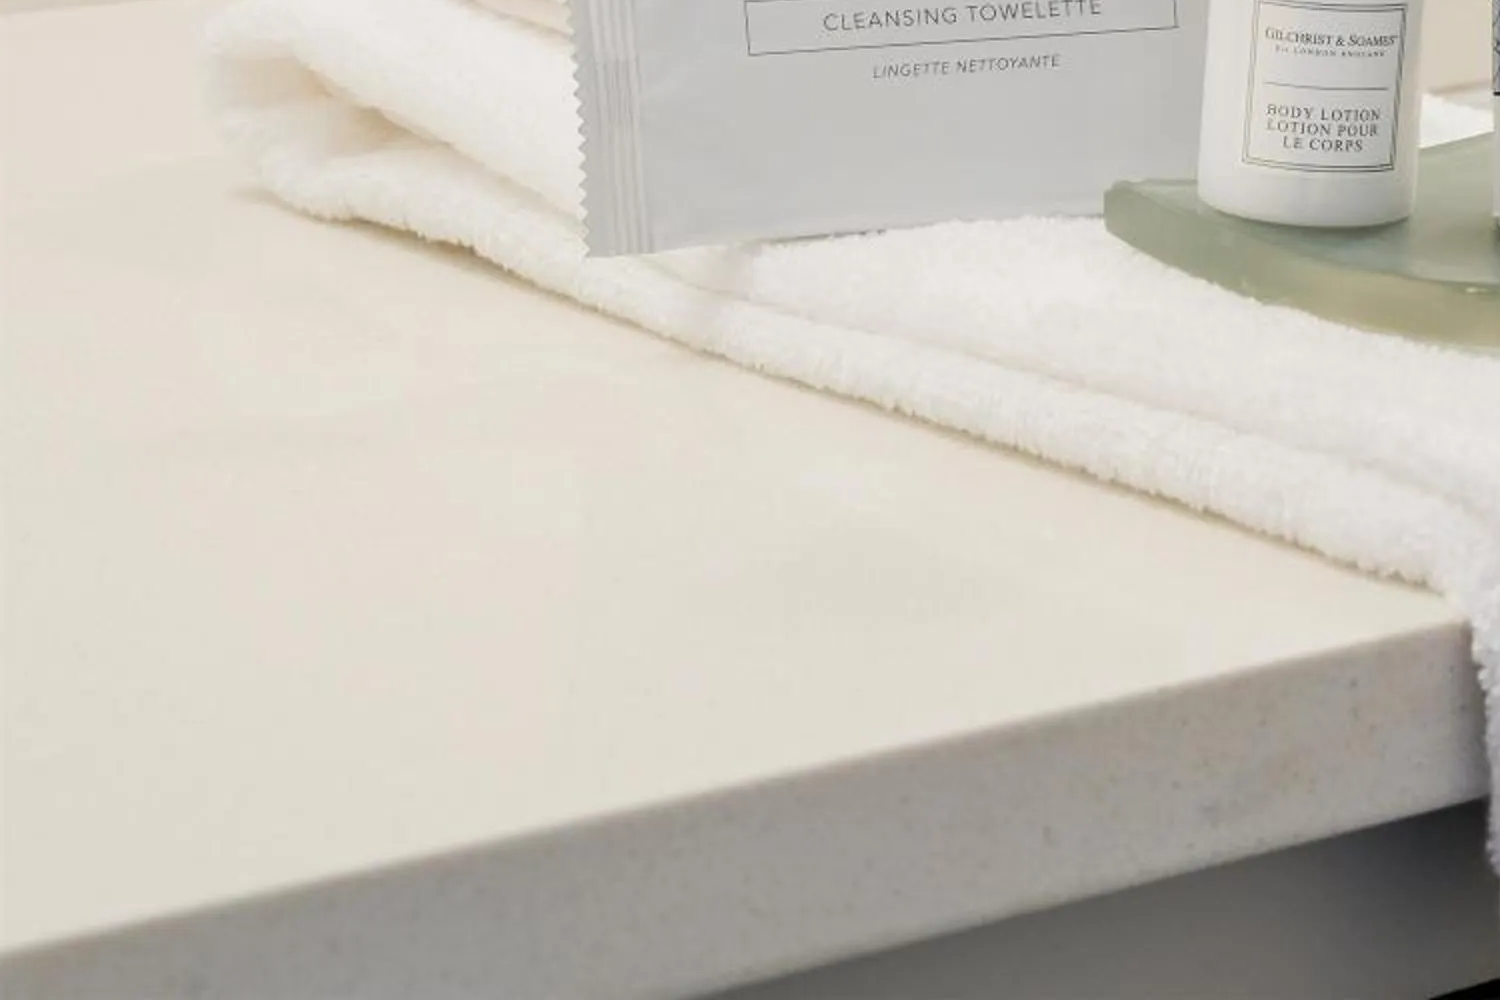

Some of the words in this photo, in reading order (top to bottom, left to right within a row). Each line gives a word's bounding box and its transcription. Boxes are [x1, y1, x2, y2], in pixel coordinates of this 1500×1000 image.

[823, 6, 957, 32] CLEANSING
[1264, 27, 1332, 45] GILCHRIST
[872, 61, 950, 79] LINGETTE
[956, 54, 1061, 73] NETTOYANTE
[1266, 103, 1313, 119] BODY
[1320, 107, 1380, 122] LOTION
[1266, 117, 1332, 136] LOTION
[1337, 123, 1377, 137] POUR
[1282, 135, 1303, 149] LE
[1308, 138, 1363, 152] CORPS
